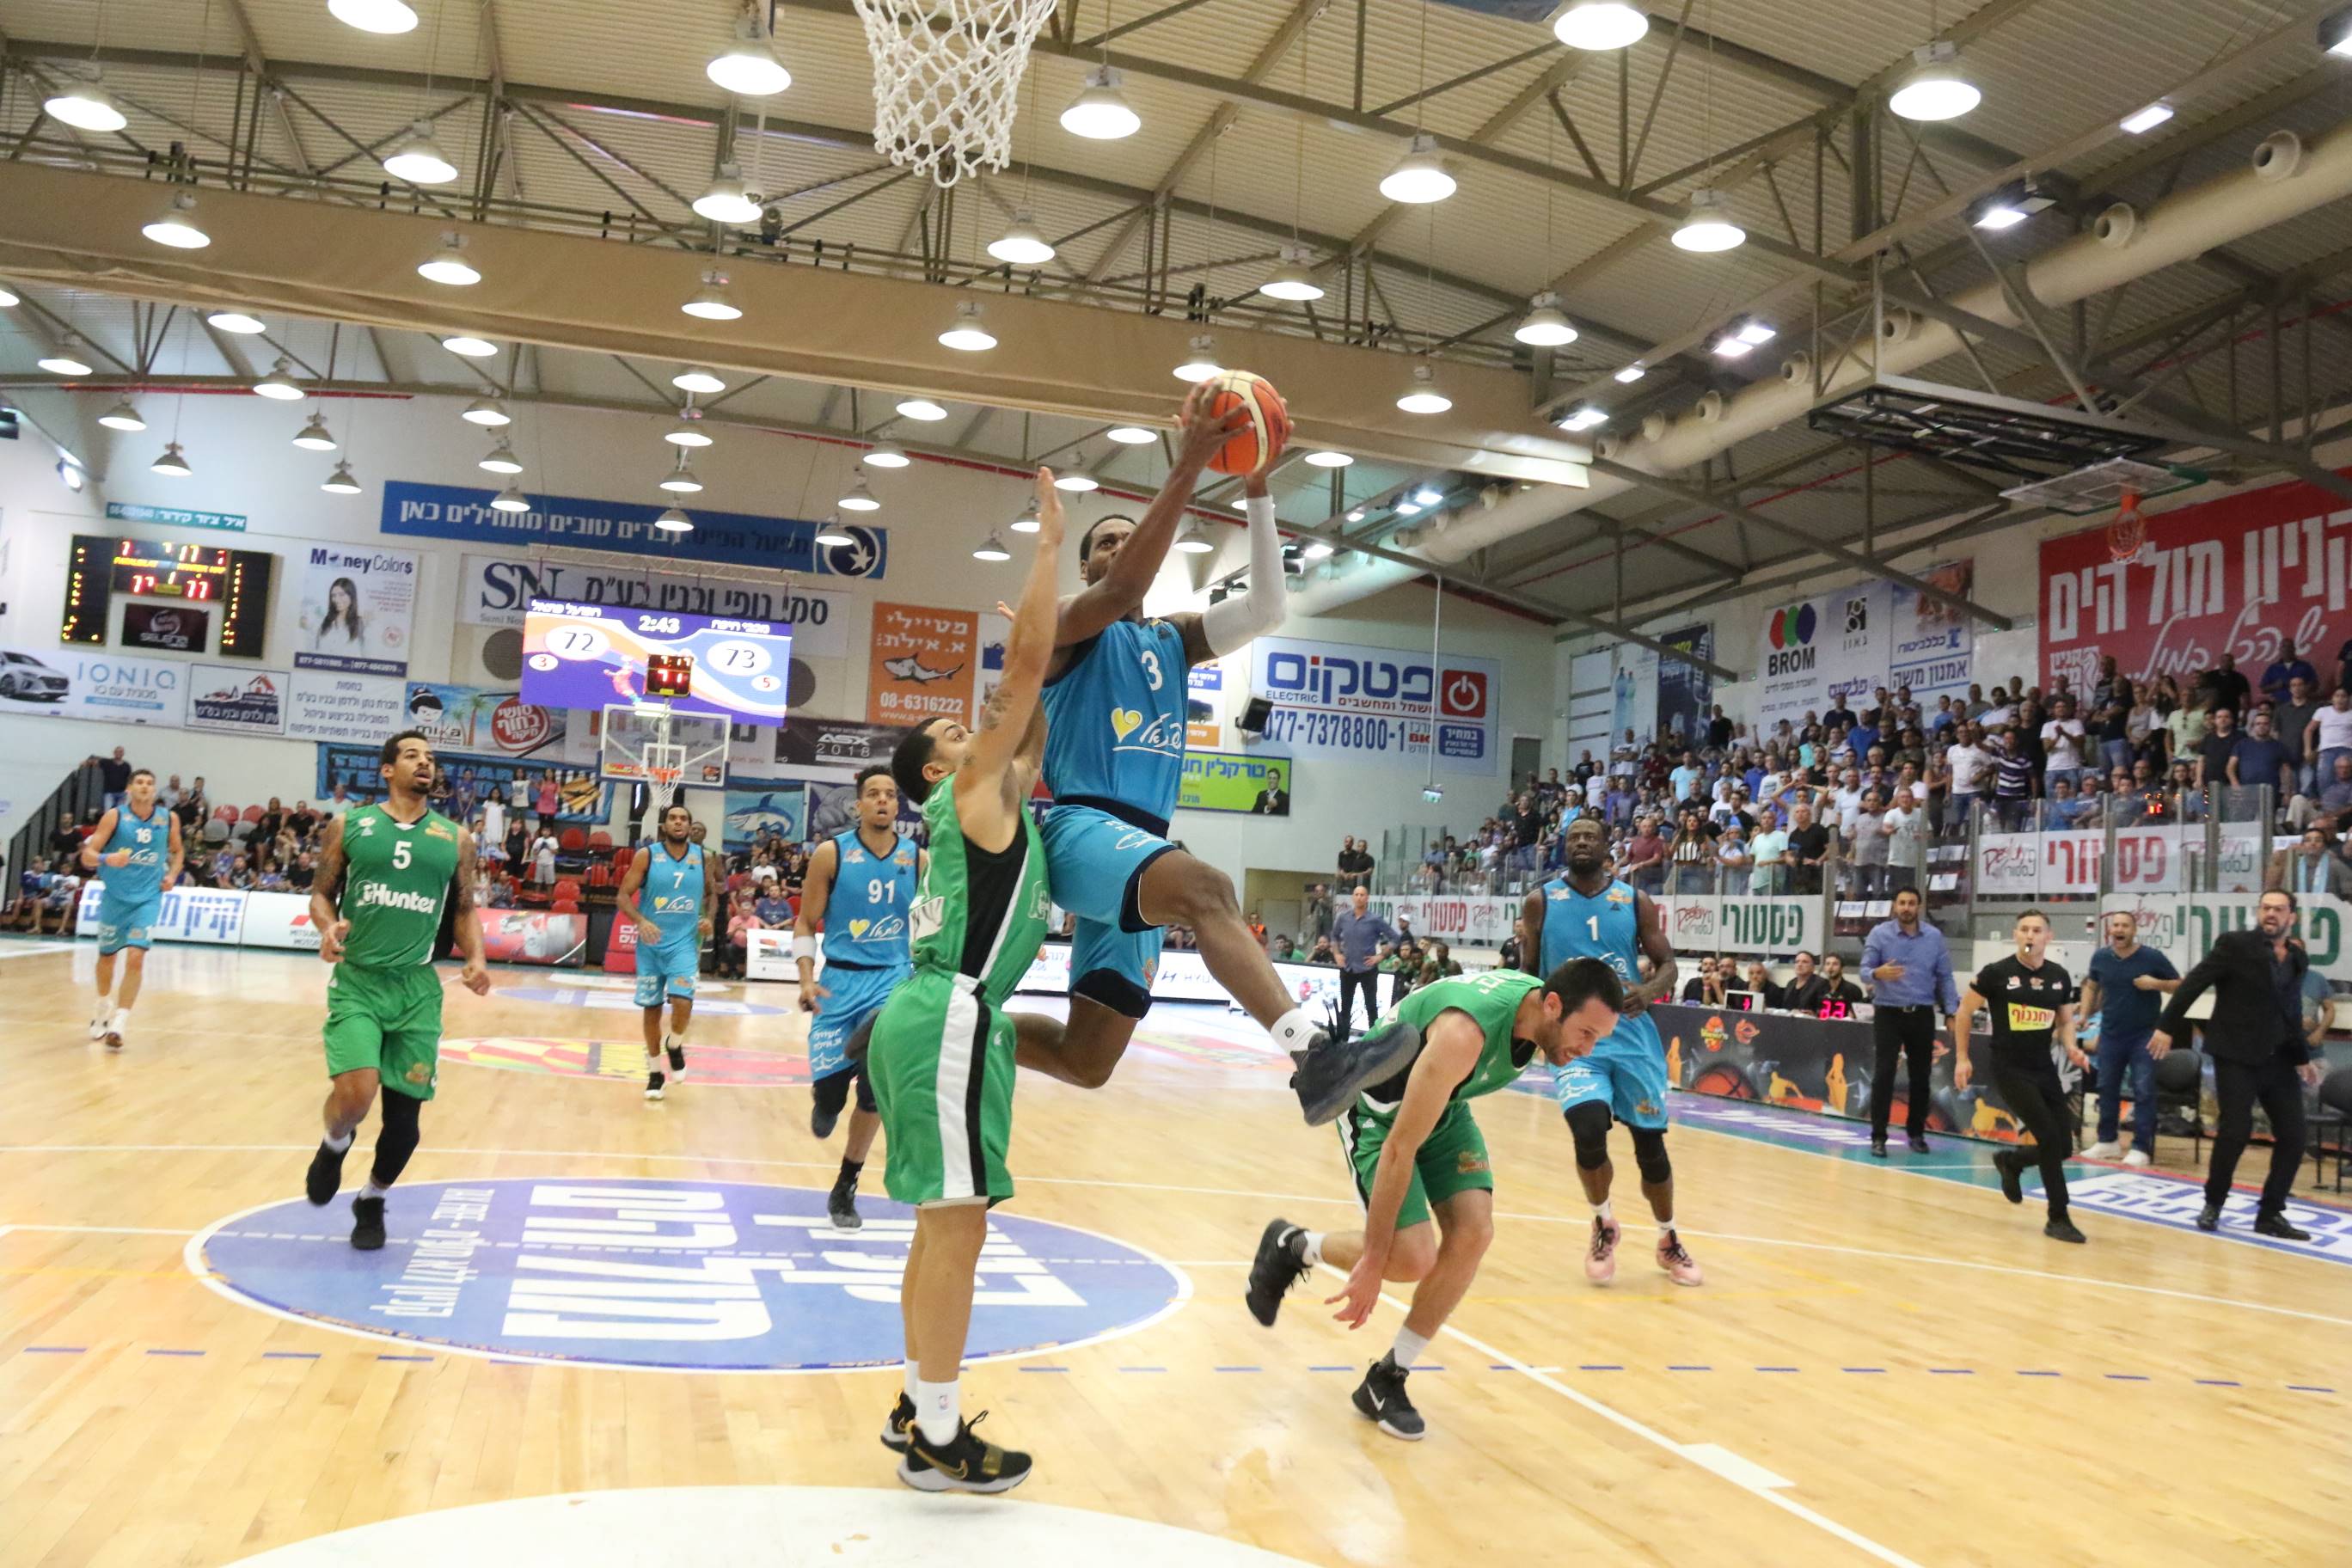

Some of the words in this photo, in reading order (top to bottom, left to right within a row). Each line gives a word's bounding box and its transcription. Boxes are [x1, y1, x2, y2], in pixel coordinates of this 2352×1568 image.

[401, 500, 440, 523] כאן
[446, 504, 542, 530] מתחילים
[549, 513, 607, 536] טובים
[481, 561, 564, 611] SN
[2148, 539, 2225, 626] מול
[2049, 560, 2128, 643] הים
[639, 615, 681, 634] 2:43
[564, 631, 594, 652] 72
[539, 657, 547, 667] 3
[726, 648, 756, 669] 73
[1142, 650, 1163, 691] 3
[1768, 647, 1816, 677] BROM
[77, 661, 176, 690] IONIQ
[763, 677, 770, 688] 5
[1267, 652, 1435, 705] פטקום
[1893, 665, 1925, 690] משה
[1928, 659, 1968, 688] אמנון
[879, 691, 964, 715] 08-6316222
[1265, 690, 1319, 703] ELECTRIC
[1338, 696, 1397, 711] ומחשבים
[498, 704, 533, 718] סושי
[497, 715, 542, 733] בחוף
[817, 743, 871, 758] 2018
[818, 733, 872, 746] ASX
[392, 840, 413, 870] 5
[673, 871, 683, 890] 7
[868, 879, 896, 904] 91
[1423, 901, 1467, 934] פסטורי
[1585, 915, 1599, 942] 1
[1721, 903, 1804, 946] פסטורי
